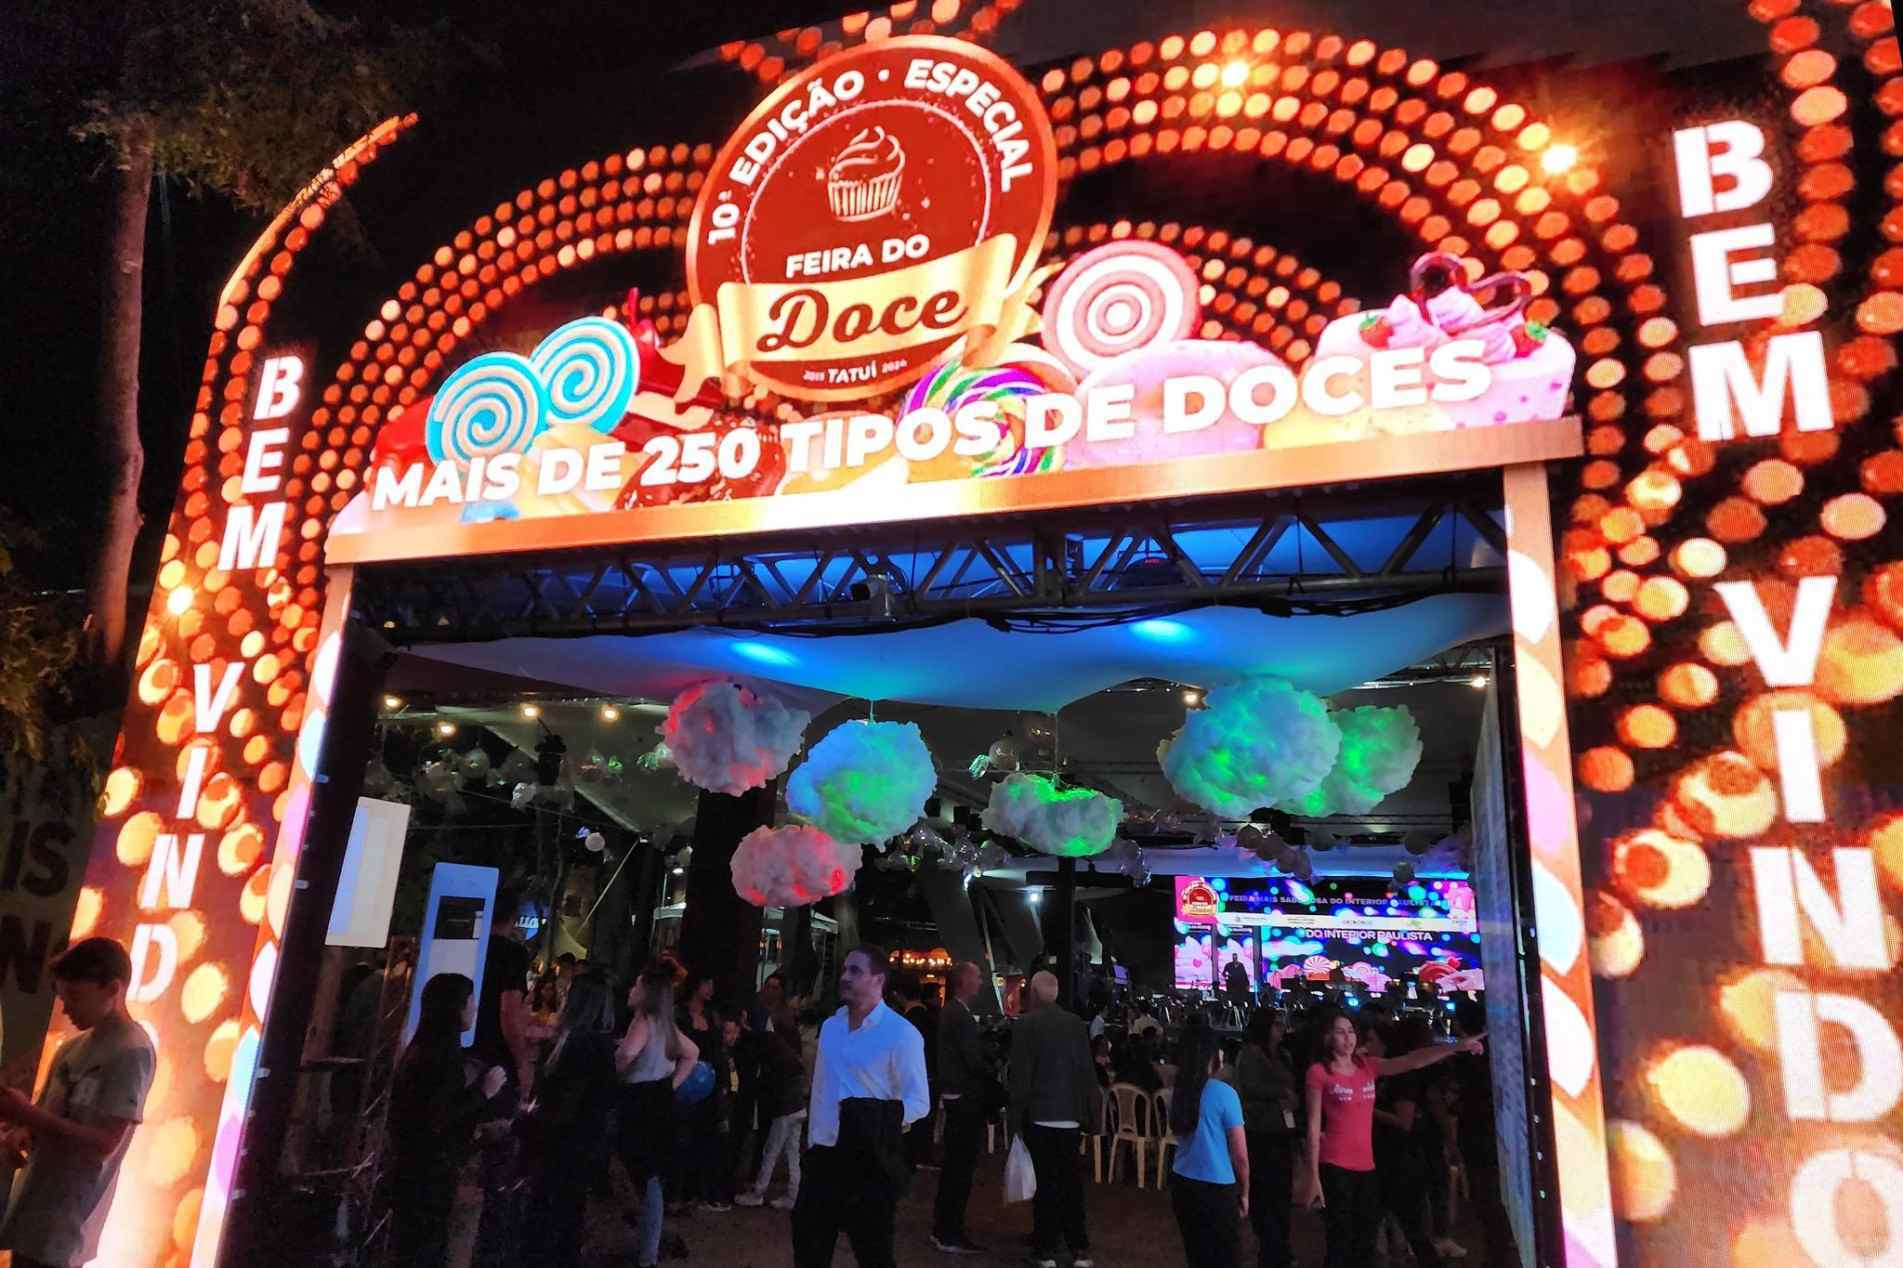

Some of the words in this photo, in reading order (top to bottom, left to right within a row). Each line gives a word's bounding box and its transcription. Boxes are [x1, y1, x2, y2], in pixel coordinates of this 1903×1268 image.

[729, 70, 864, 186] EDIÇÃO
[904, 59, 1032, 192] ESPECIAL
[756, 288, 969, 352] Doce
[786, 244, 873, 278] FEIRA
[881, 234, 930, 264] DO
[1674, 120, 1834, 442] BEM
[371, 452, 520, 511] MAIS
[537, 441, 625, 497] DE
[639, 427, 761, 487] 250
[779, 404, 1003, 475] TIPOS
[1025, 385, 1135, 449] DE
[1163, 339, 1492, 435] DOCES
[828, 360, 877, 384] TATUÍ
[217, 355, 304, 571] BEM
[126, 662, 246, 1052] VIND
[1714, 575, 1903, 1268] VINDO
[1306, 929, 1324, 938] DO
[1324, 930, 1376, 940] INTERIOR
[1377, 931, 1433, 941] PAULISTA
